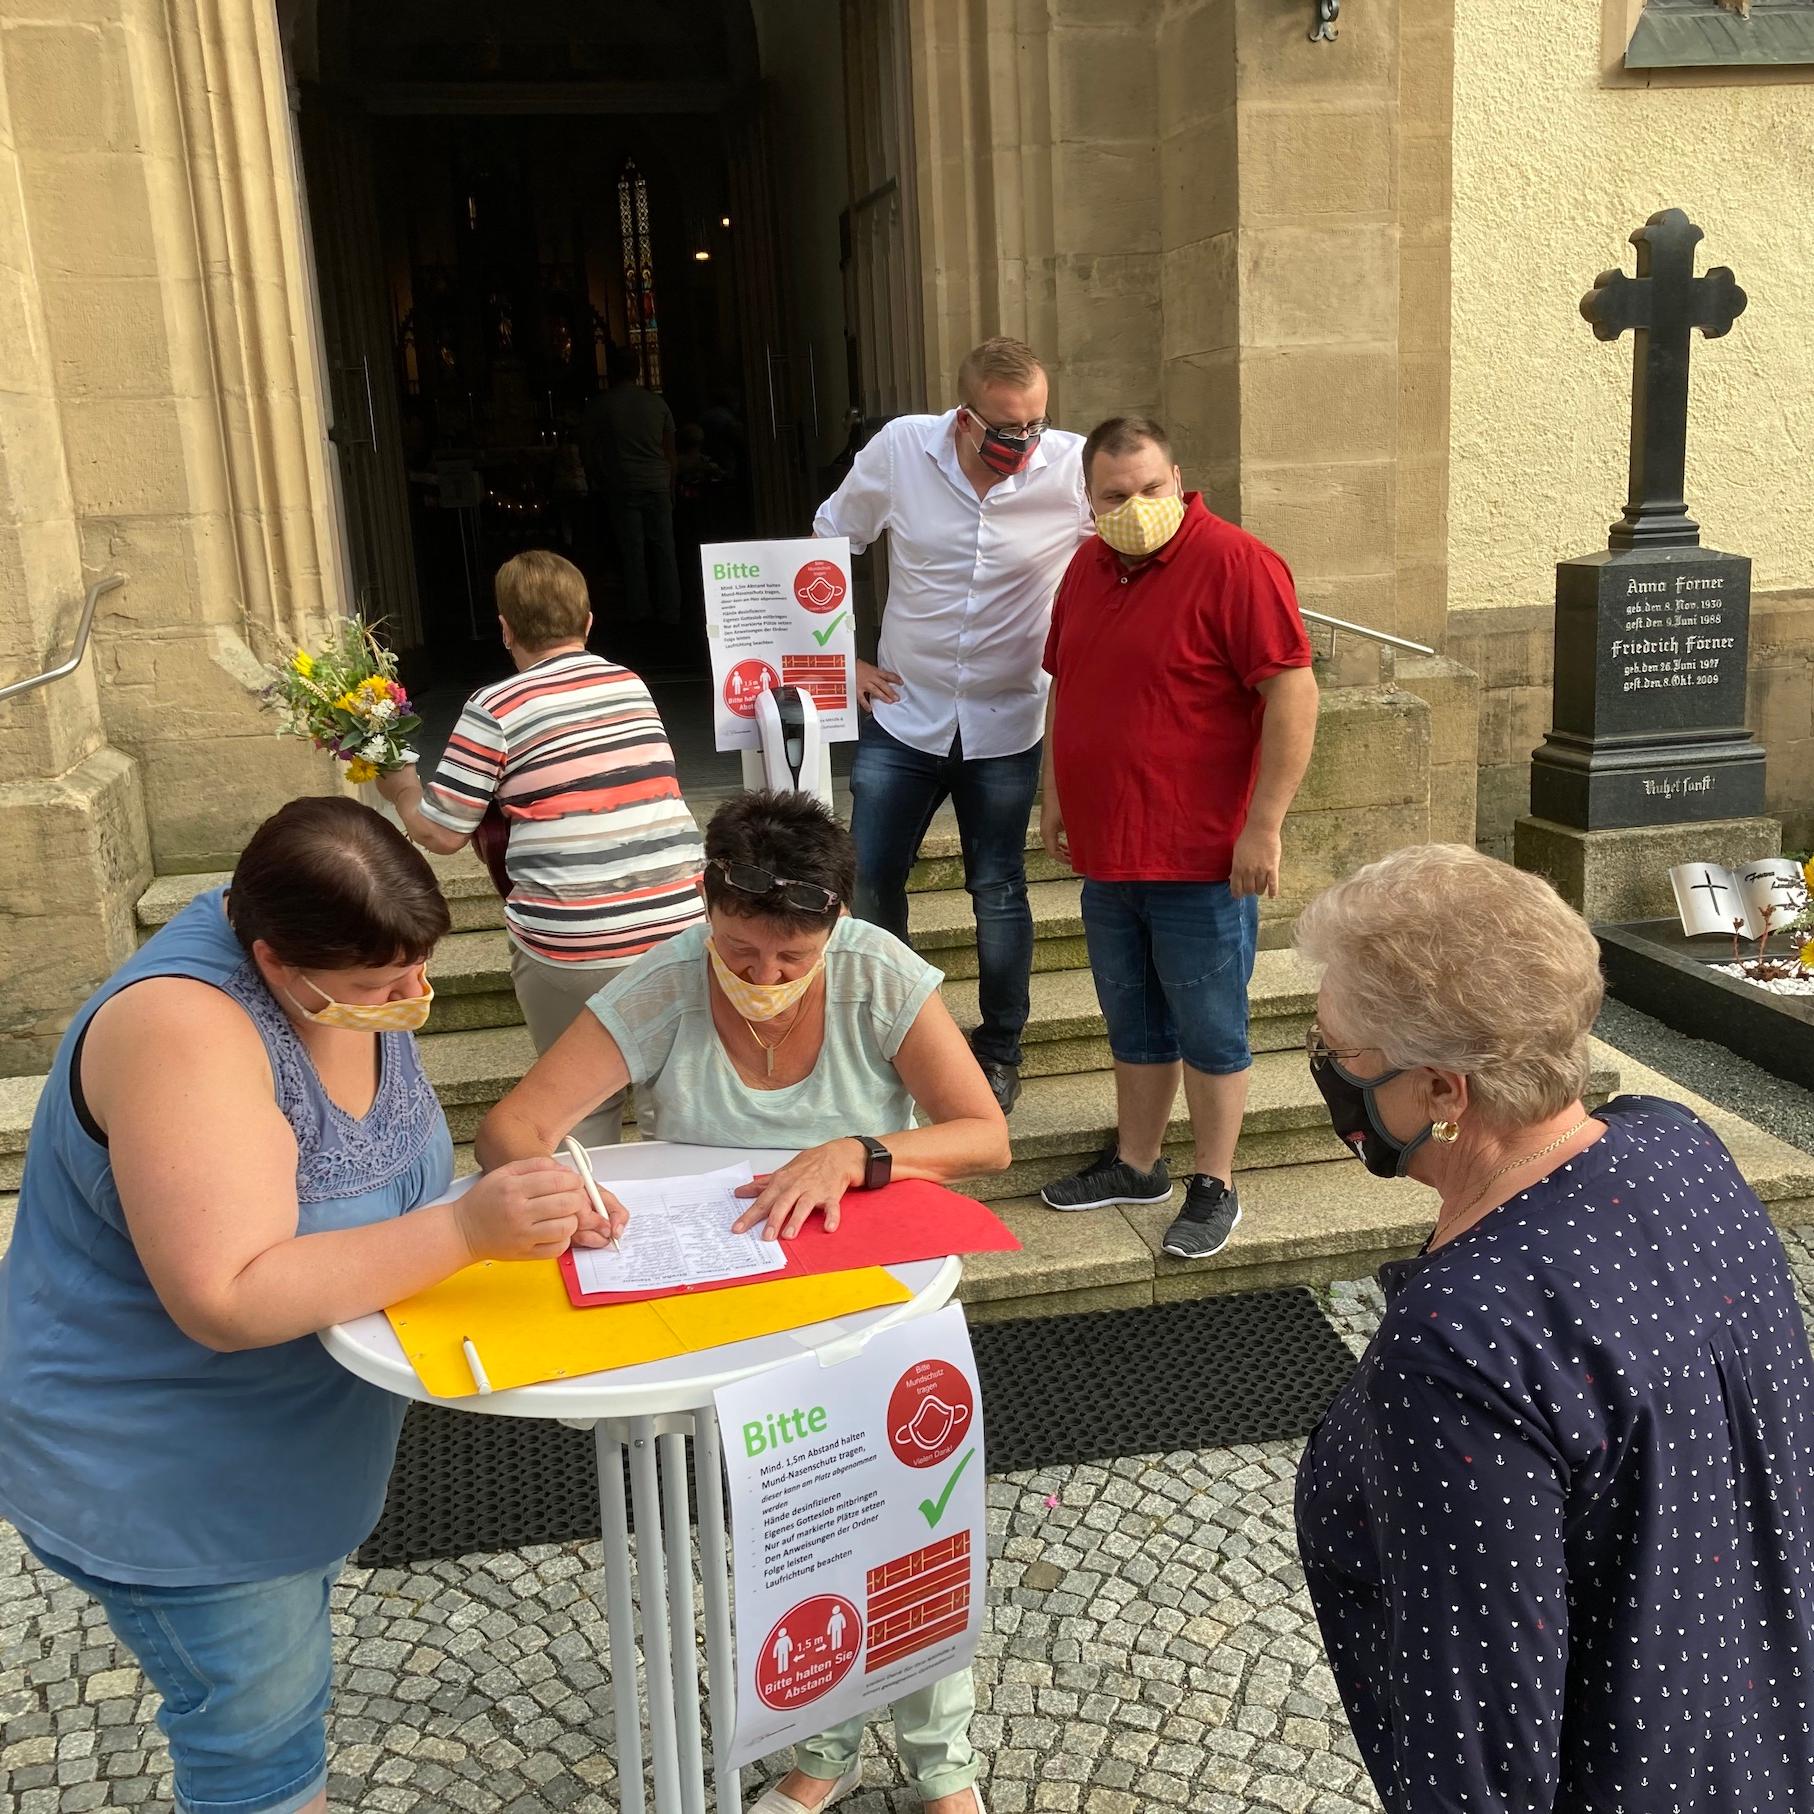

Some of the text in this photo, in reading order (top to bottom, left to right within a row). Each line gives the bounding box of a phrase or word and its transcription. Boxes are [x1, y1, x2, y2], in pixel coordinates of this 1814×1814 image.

[714, 562, 759, 580] Bitte
[1627, 579, 1666, 596] Anna
[1673, 615, 1697, 627] Juni
[1700, 614, 1721, 624] 1988
[1611, 635, 1734, 658] Friedrich Förner
[1673, 659, 1696, 672] Juni
[1700, 659, 1719, 669] 1927
[1697, 675, 1719, 685] 2009
[1643, 777, 1680, 799] Ruhet
[906, 1369, 944, 1388] Mundschutz
[916, 1364, 930, 1373] Bitte
[917, 1382, 937, 1394] tragen
[742, 1406, 827, 1457] Bitte
[760, 1431, 866, 1476] Mind. 1,5m Abstand halten
[761, 1454, 877, 1504] dieser kann am Platz abgenommen
[762, 1445, 866, 1490] Mund-Nasenschutz tragen,
[762, 1501, 788, 1515] werden
[764, 1491, 841, 1527] Hände desinfizieren
[764, 1490, 878, 1540] Eigenes Gotteslob mitbringen
[764, 1499, 885, 1552] Nur auf markierte Plätze setzen
[765, 1514, 879, 1565] Den Anweisungen der Ordner
[764, 1552, 813, 1578] Folge leisten
[766, 1549, 853, 1590] Laufrichtung beachten
[814, 1636, 823, 1645] m
[765, 1651, 853, 1695] Bitte halten Sie
[785, 1671, 832, 1700] Abstand
